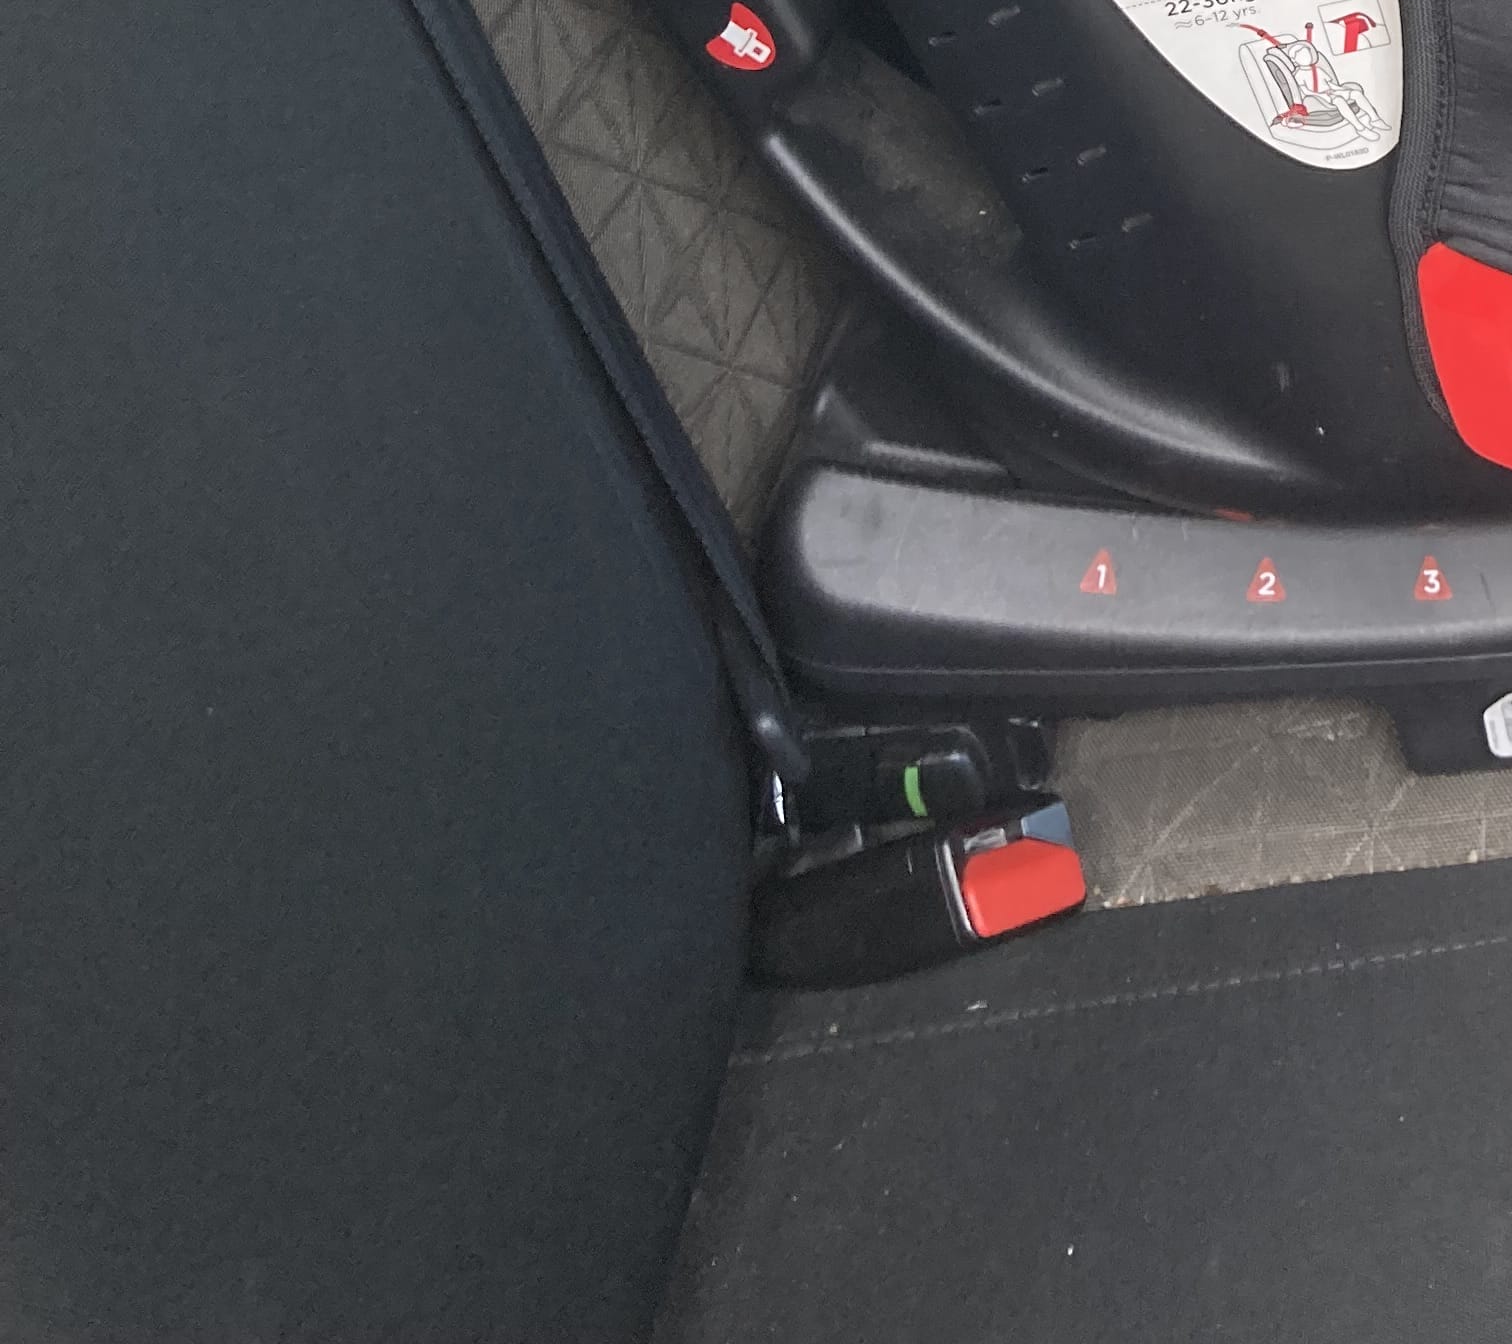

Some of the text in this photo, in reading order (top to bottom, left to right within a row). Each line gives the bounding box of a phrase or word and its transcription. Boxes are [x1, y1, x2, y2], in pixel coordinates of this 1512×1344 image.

[1097, 565, 1108, 588] 1
[1258, 572, 1277, 596] 2
[1423, 569, 1441, 593] 3
